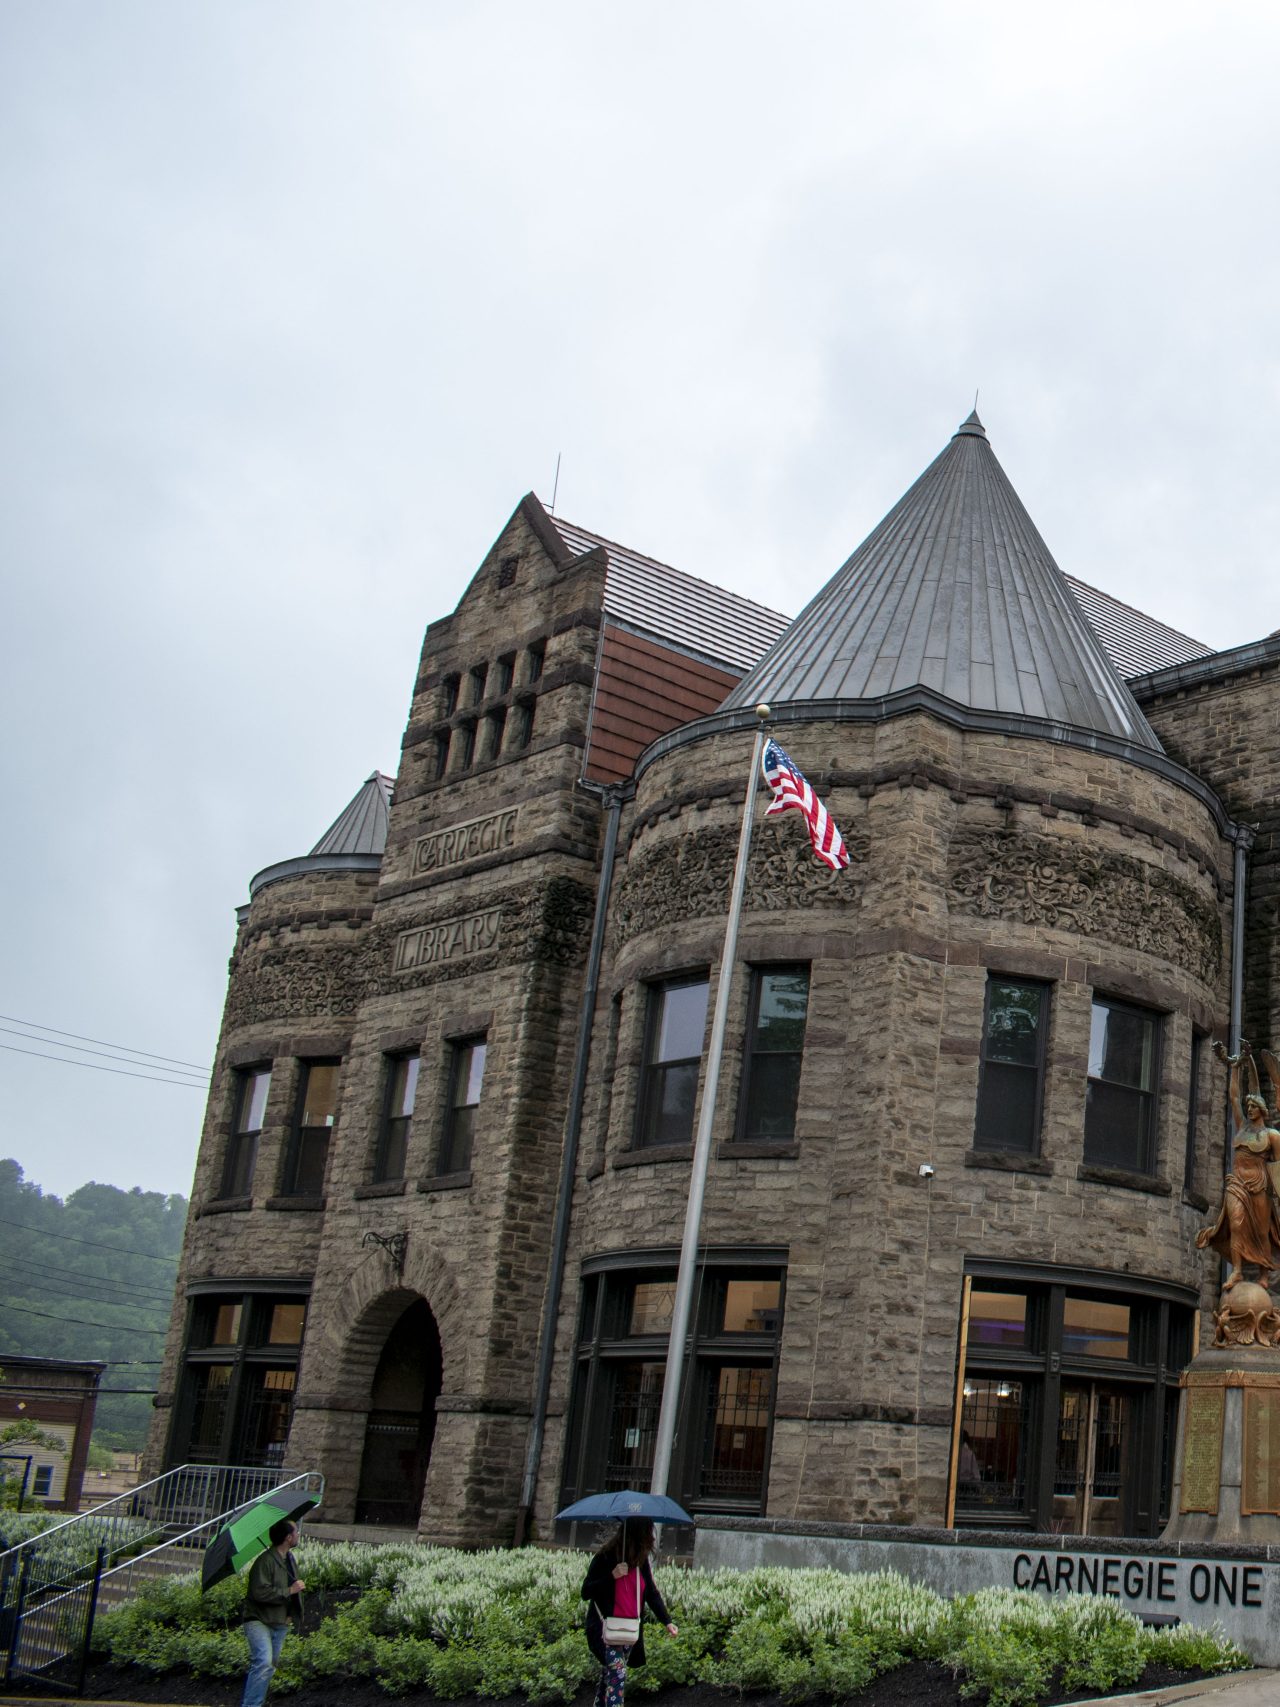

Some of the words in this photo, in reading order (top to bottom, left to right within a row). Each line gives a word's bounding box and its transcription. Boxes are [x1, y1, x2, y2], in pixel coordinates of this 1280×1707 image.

[416, 811, 517, 872] CARNEGIE
[396, 911, 501, 970] LIBRARY
[1013, 1553, 1177, 1601] CARNEGIE
[1189, 1563, 1264, 1607] ONE
